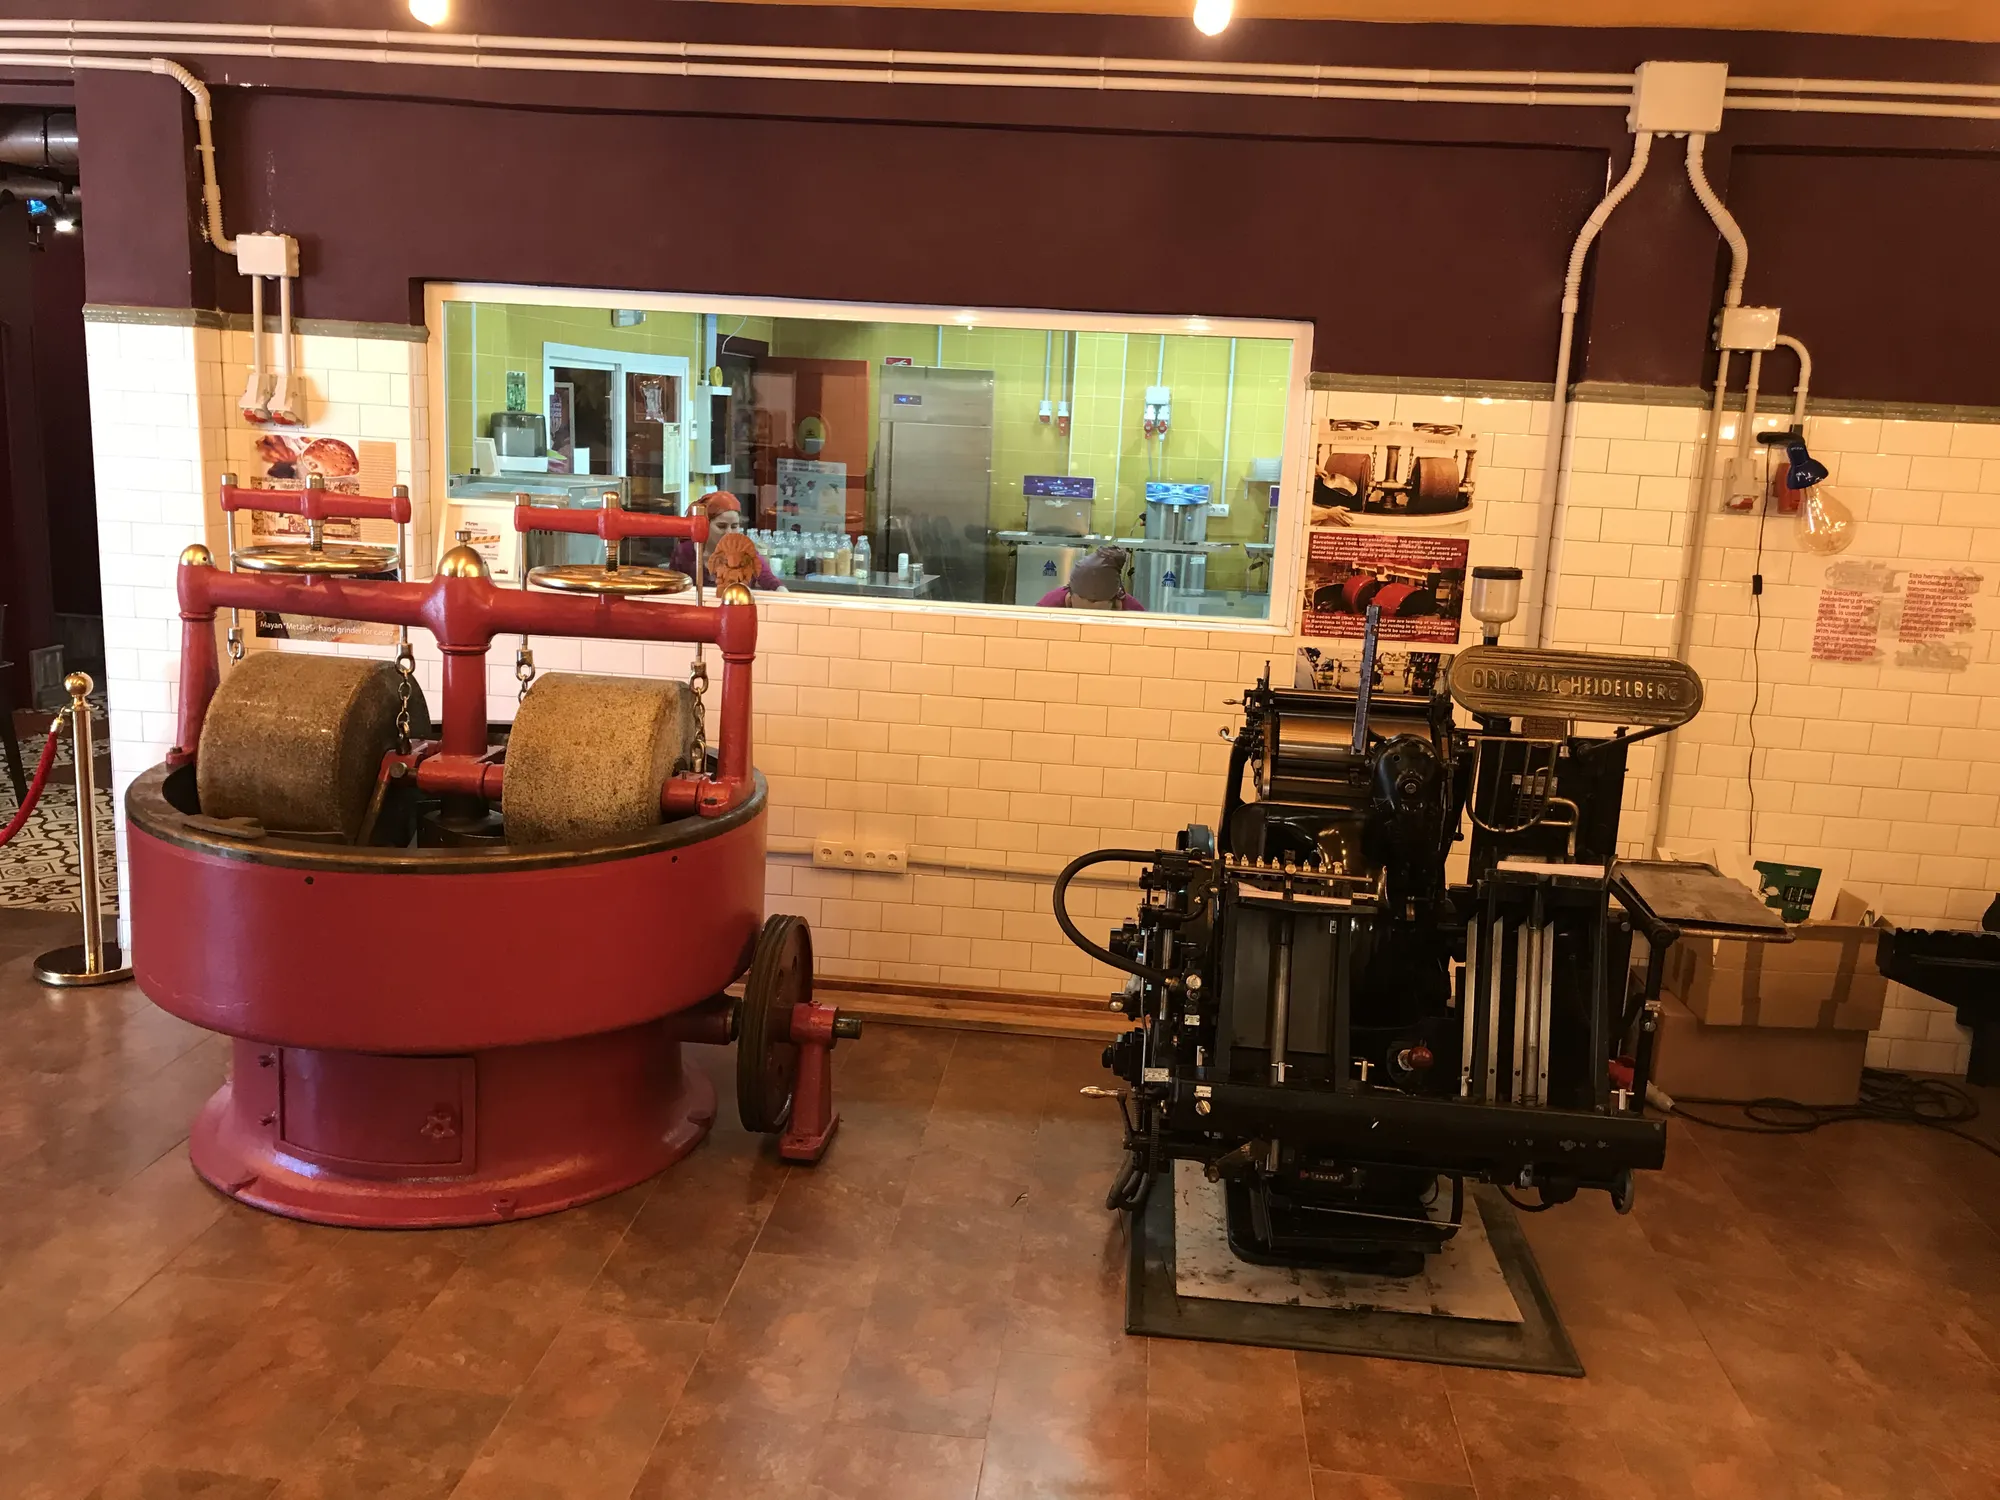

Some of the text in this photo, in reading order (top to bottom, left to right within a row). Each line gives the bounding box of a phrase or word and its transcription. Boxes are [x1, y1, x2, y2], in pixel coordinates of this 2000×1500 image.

[260, 621, 282, 630] Mayan
[337, 626, 361, 635] grinder
[1471, 668, 1680, 702] ORIGINAL HEIDELBERG
